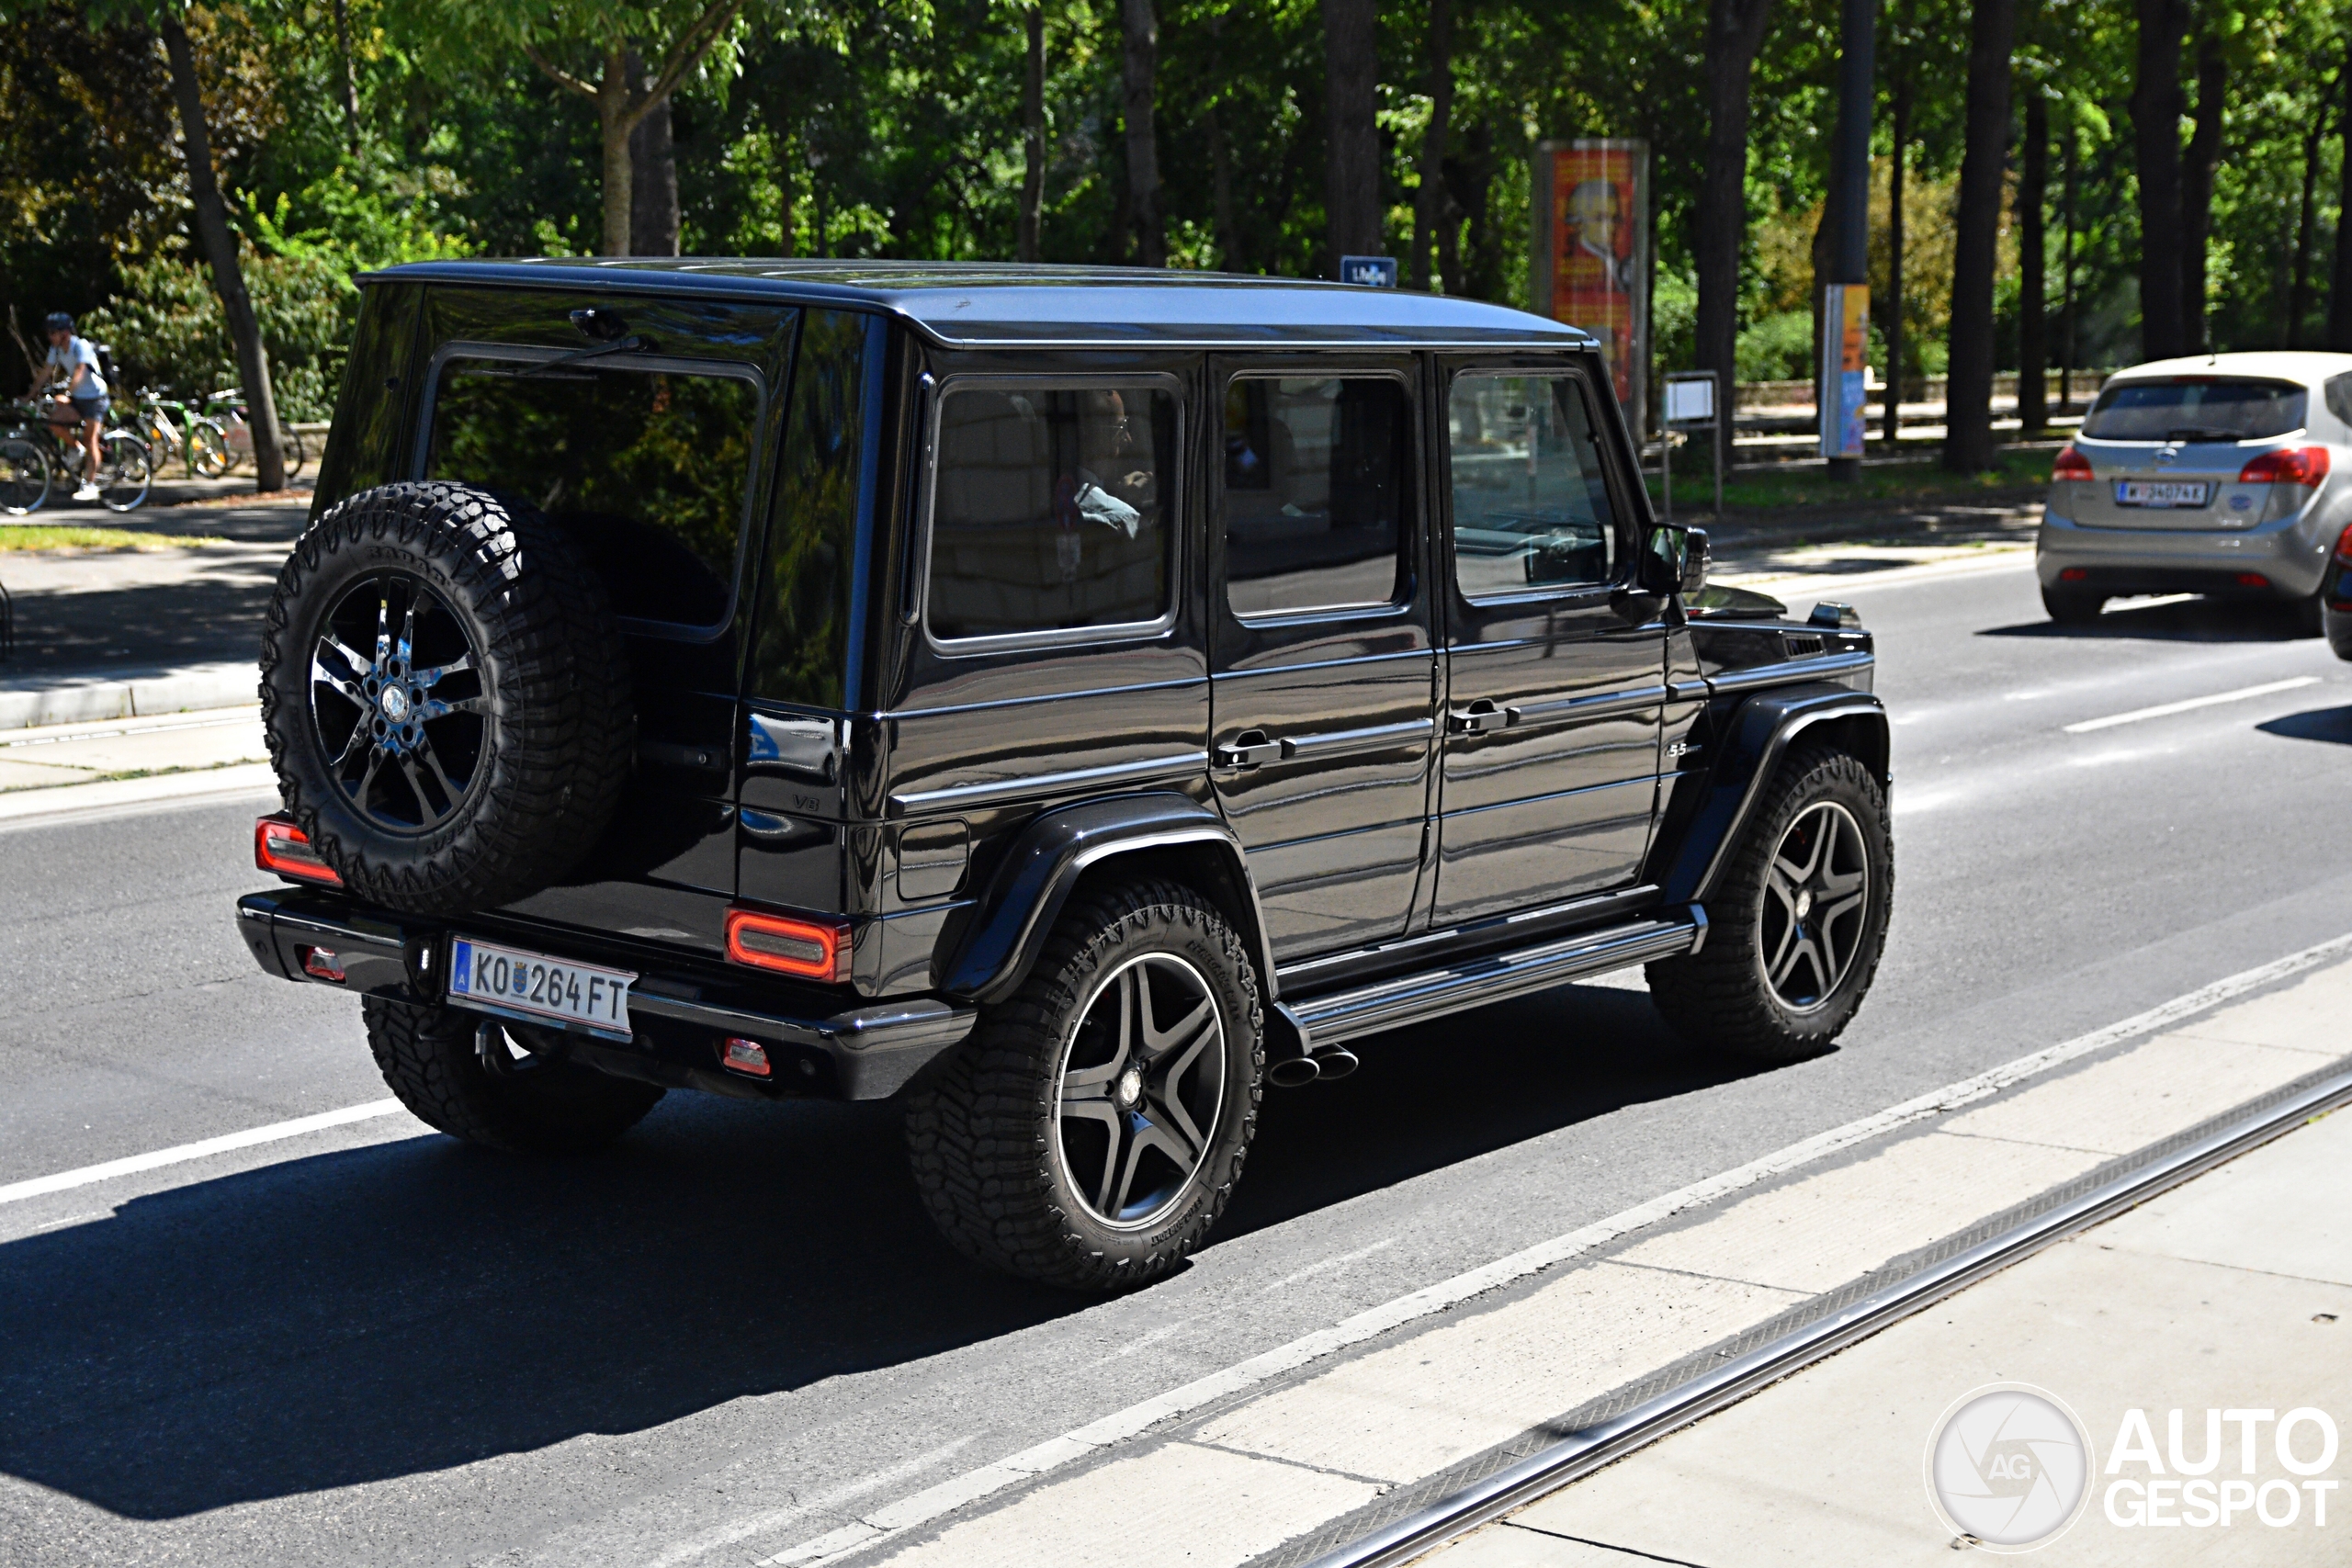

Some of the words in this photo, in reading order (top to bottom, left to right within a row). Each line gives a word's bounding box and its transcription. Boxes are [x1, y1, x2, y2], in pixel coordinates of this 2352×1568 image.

[793, 795, 820, 811] V8
[458, 975, 466, 986] A
[475, 952, 508, 995] KO
[530, 964, 581, 1011] 264
[587, 975, 625, 1020] FT
